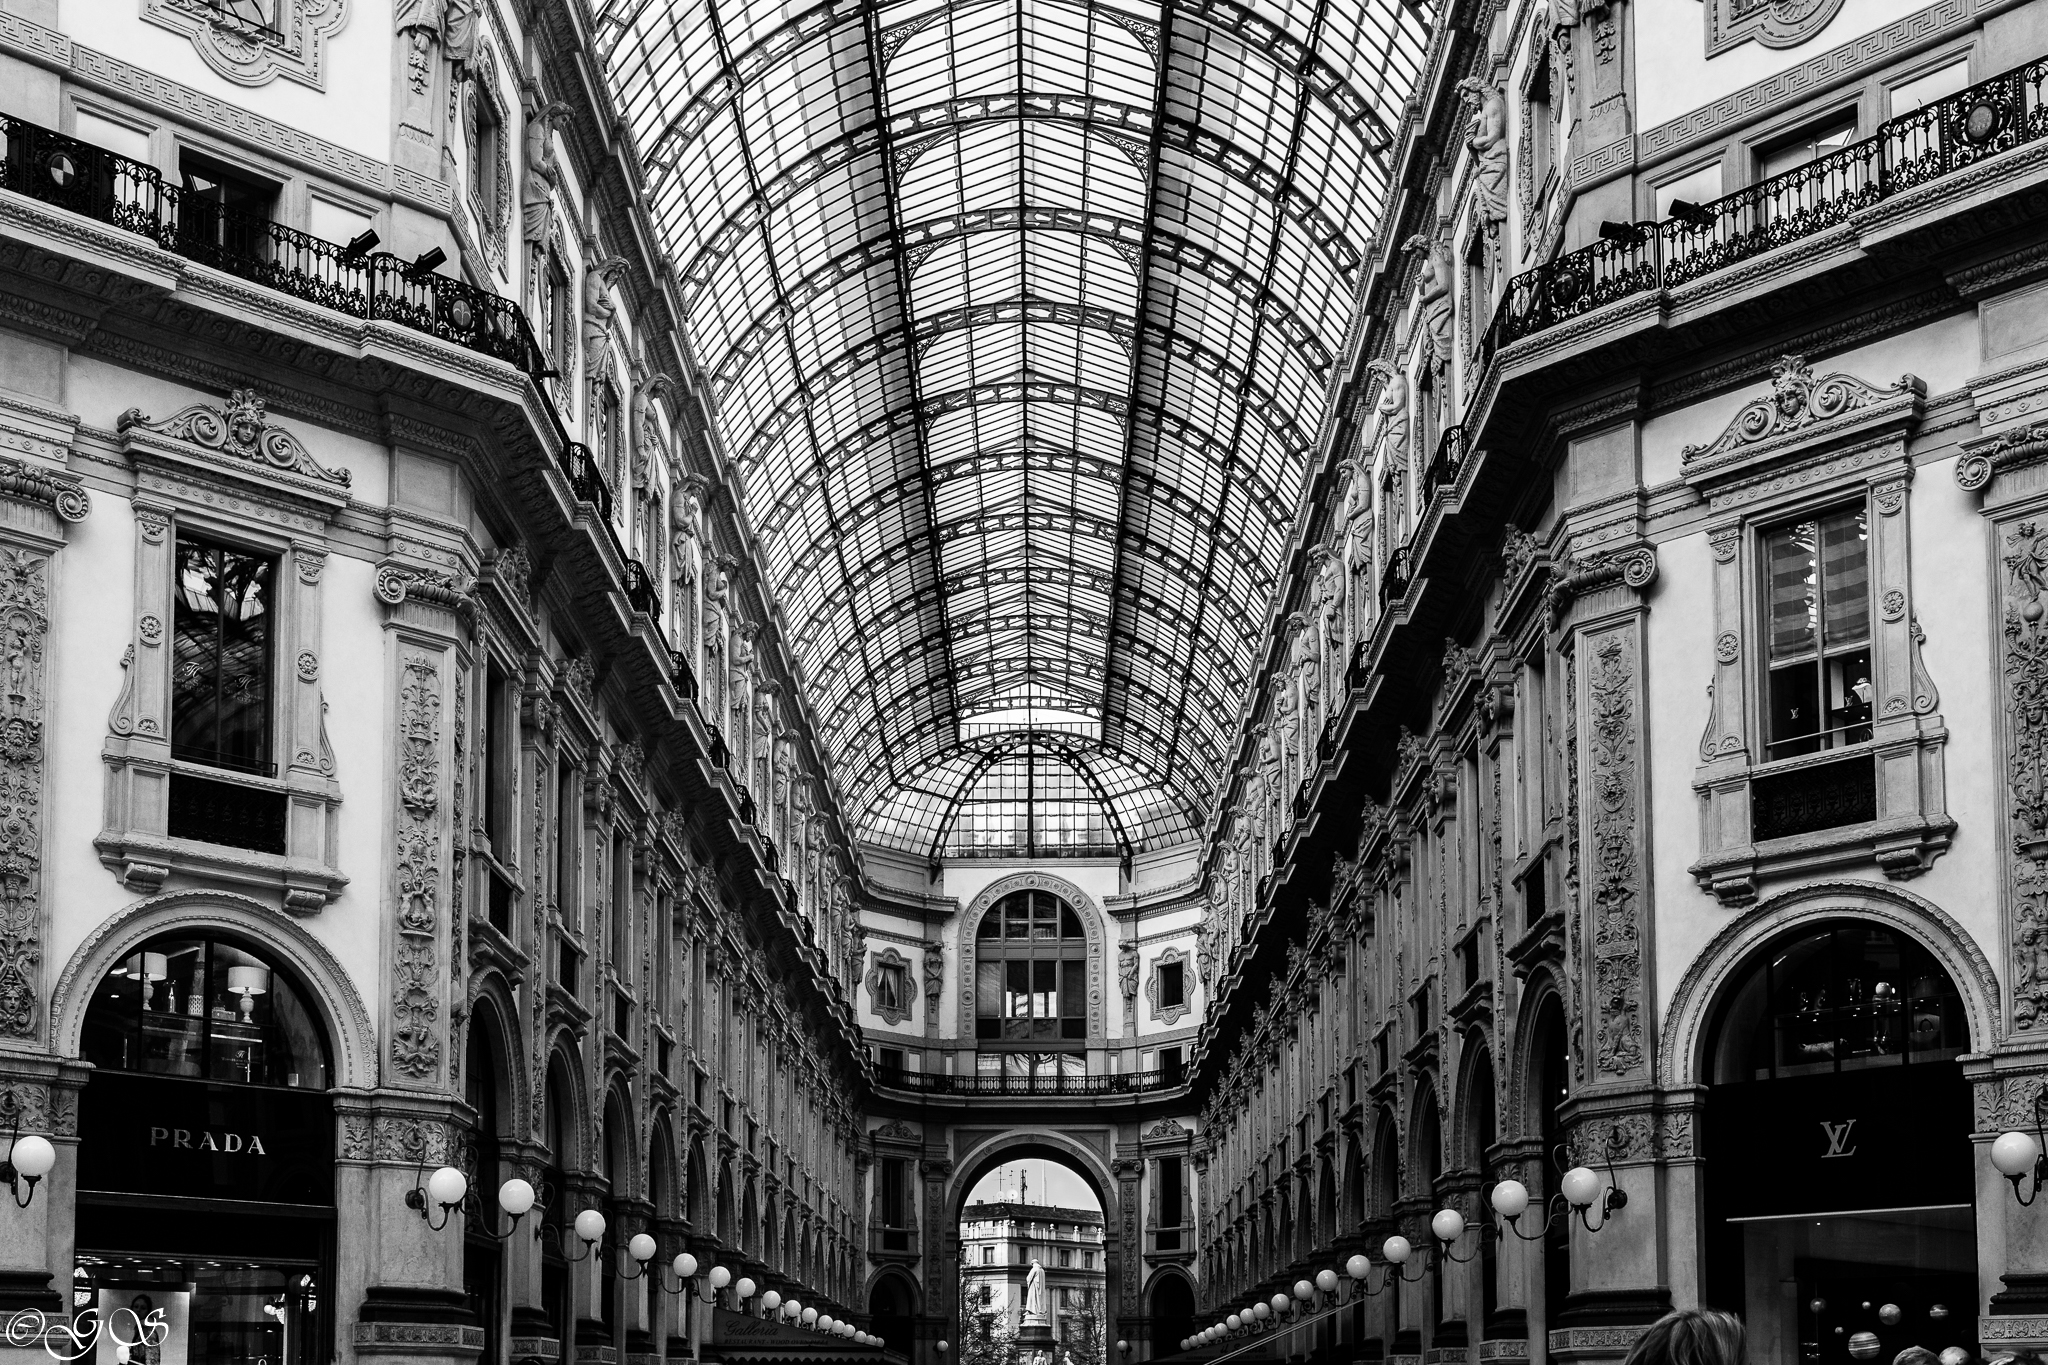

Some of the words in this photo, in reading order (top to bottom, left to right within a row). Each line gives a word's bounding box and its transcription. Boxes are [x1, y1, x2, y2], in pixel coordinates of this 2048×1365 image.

[150, 1126, 266, 1155] PRADA
[1820, 1119, 1857, 1158] LV
[724, 1320, 779, 1336] Galleria
